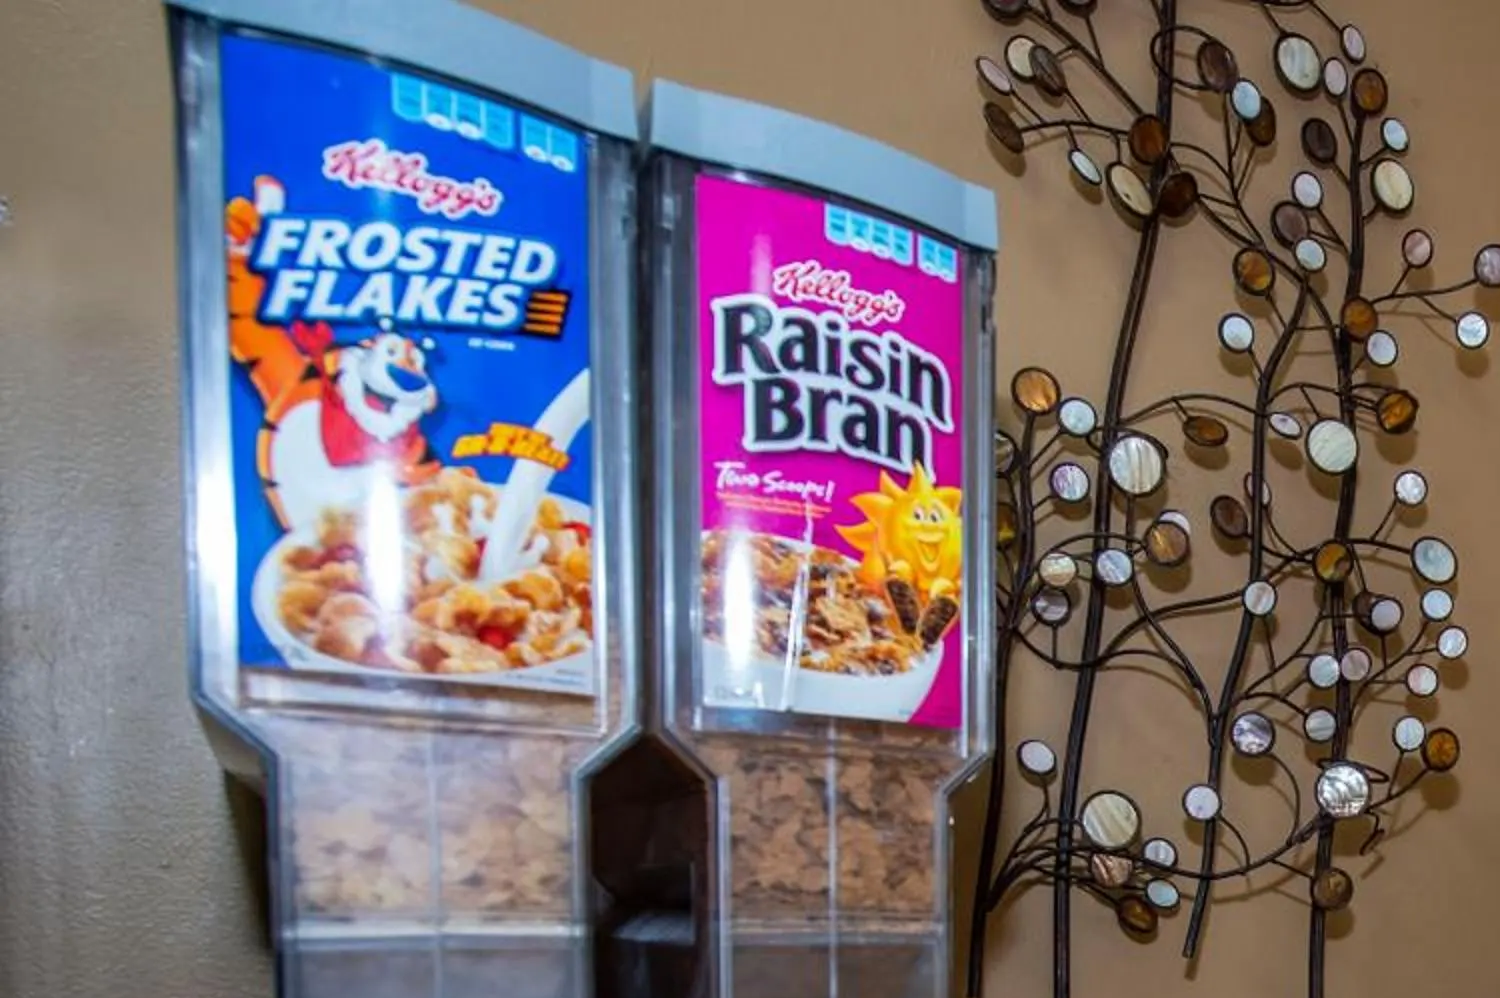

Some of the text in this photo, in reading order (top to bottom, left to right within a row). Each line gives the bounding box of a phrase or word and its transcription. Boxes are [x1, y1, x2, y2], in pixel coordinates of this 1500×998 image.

[324, 139, 502, 217] Kellogg's
[255, 218, 557, 285] FROSTED
[261, 269, 524, 327] FLAKES
[775, 261, 904, 325] Kellogg's
[716, 300, 950, 428] Raisin
[749, 377, 930, 472] Bran
